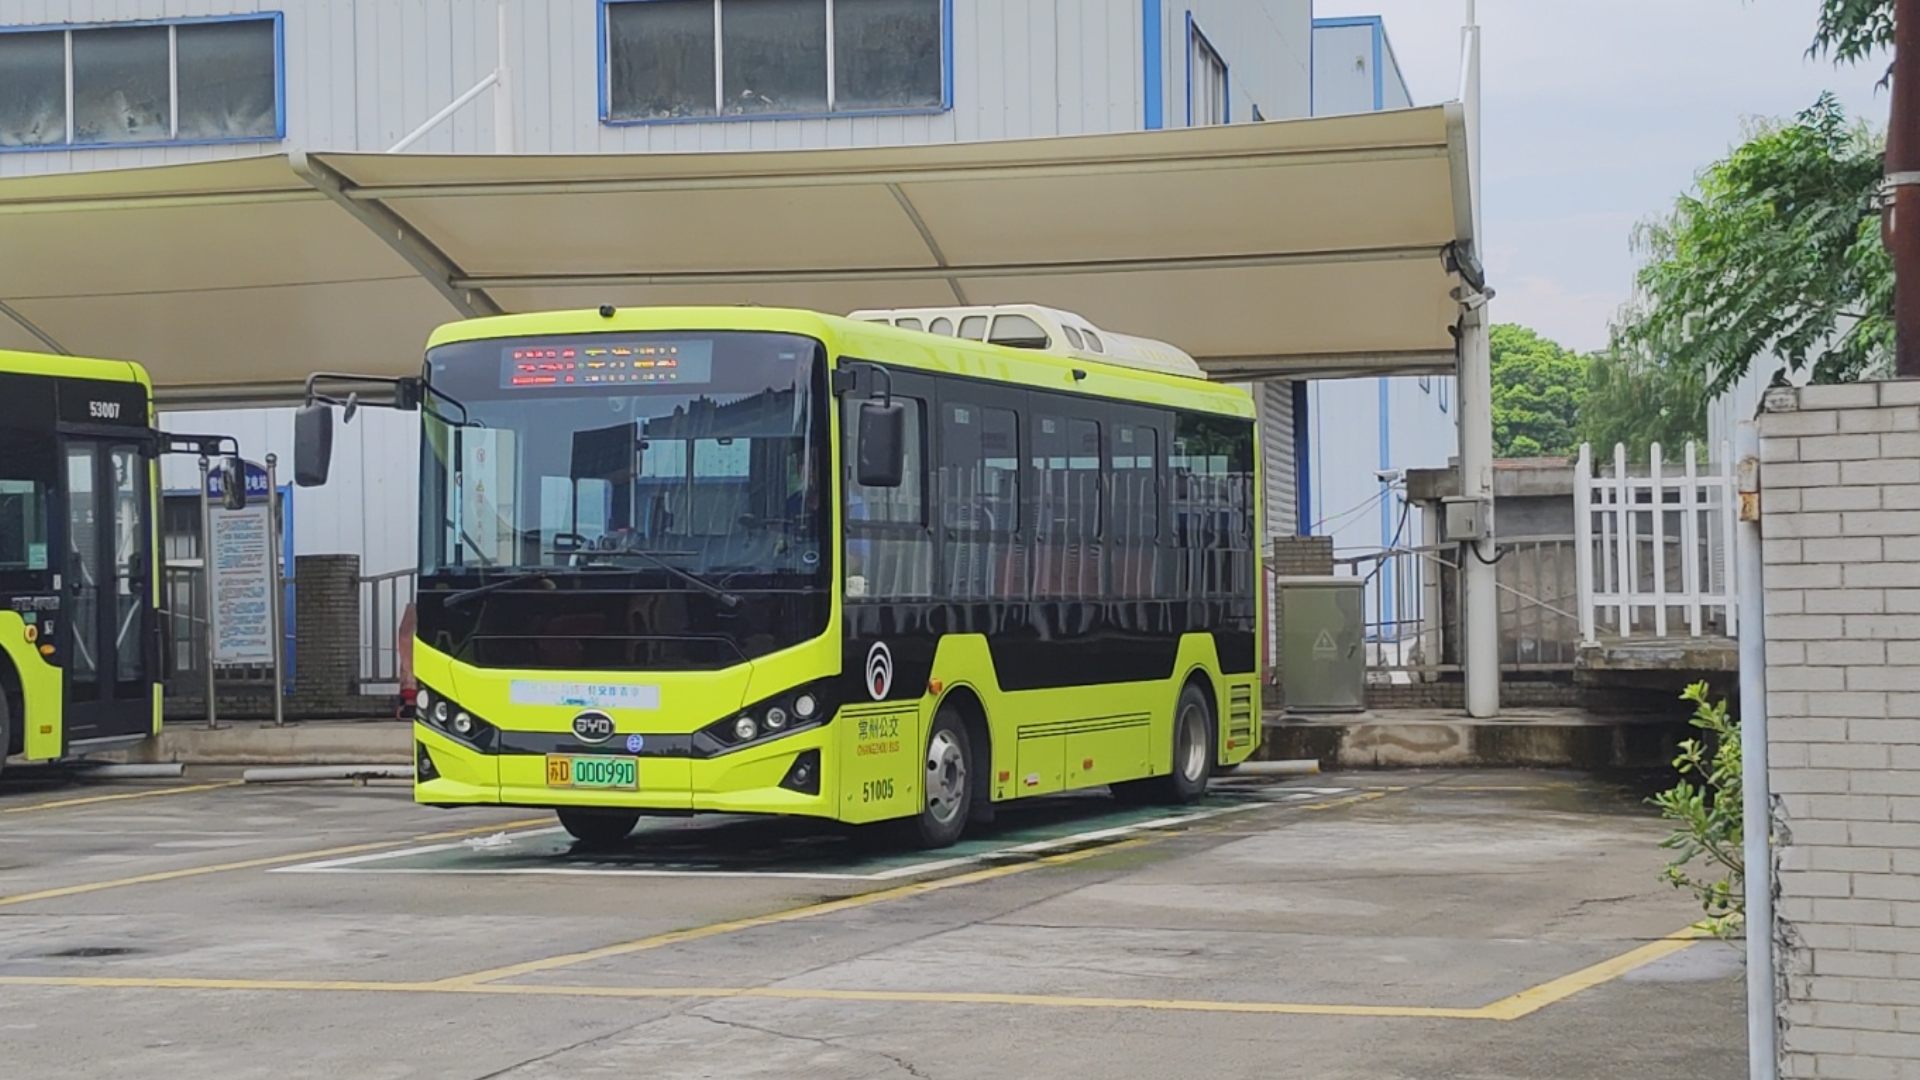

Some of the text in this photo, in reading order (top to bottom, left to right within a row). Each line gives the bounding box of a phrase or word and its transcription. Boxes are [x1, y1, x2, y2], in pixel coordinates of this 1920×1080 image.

[90, 401, 120, 419] 53007
[576, 719, 610, 733] BYD
[858, 715, 899, 740] 常州公交
[857, 741, 900, 756] CHANGZHOU BUS
[863, 777, 894, 803] 51005
